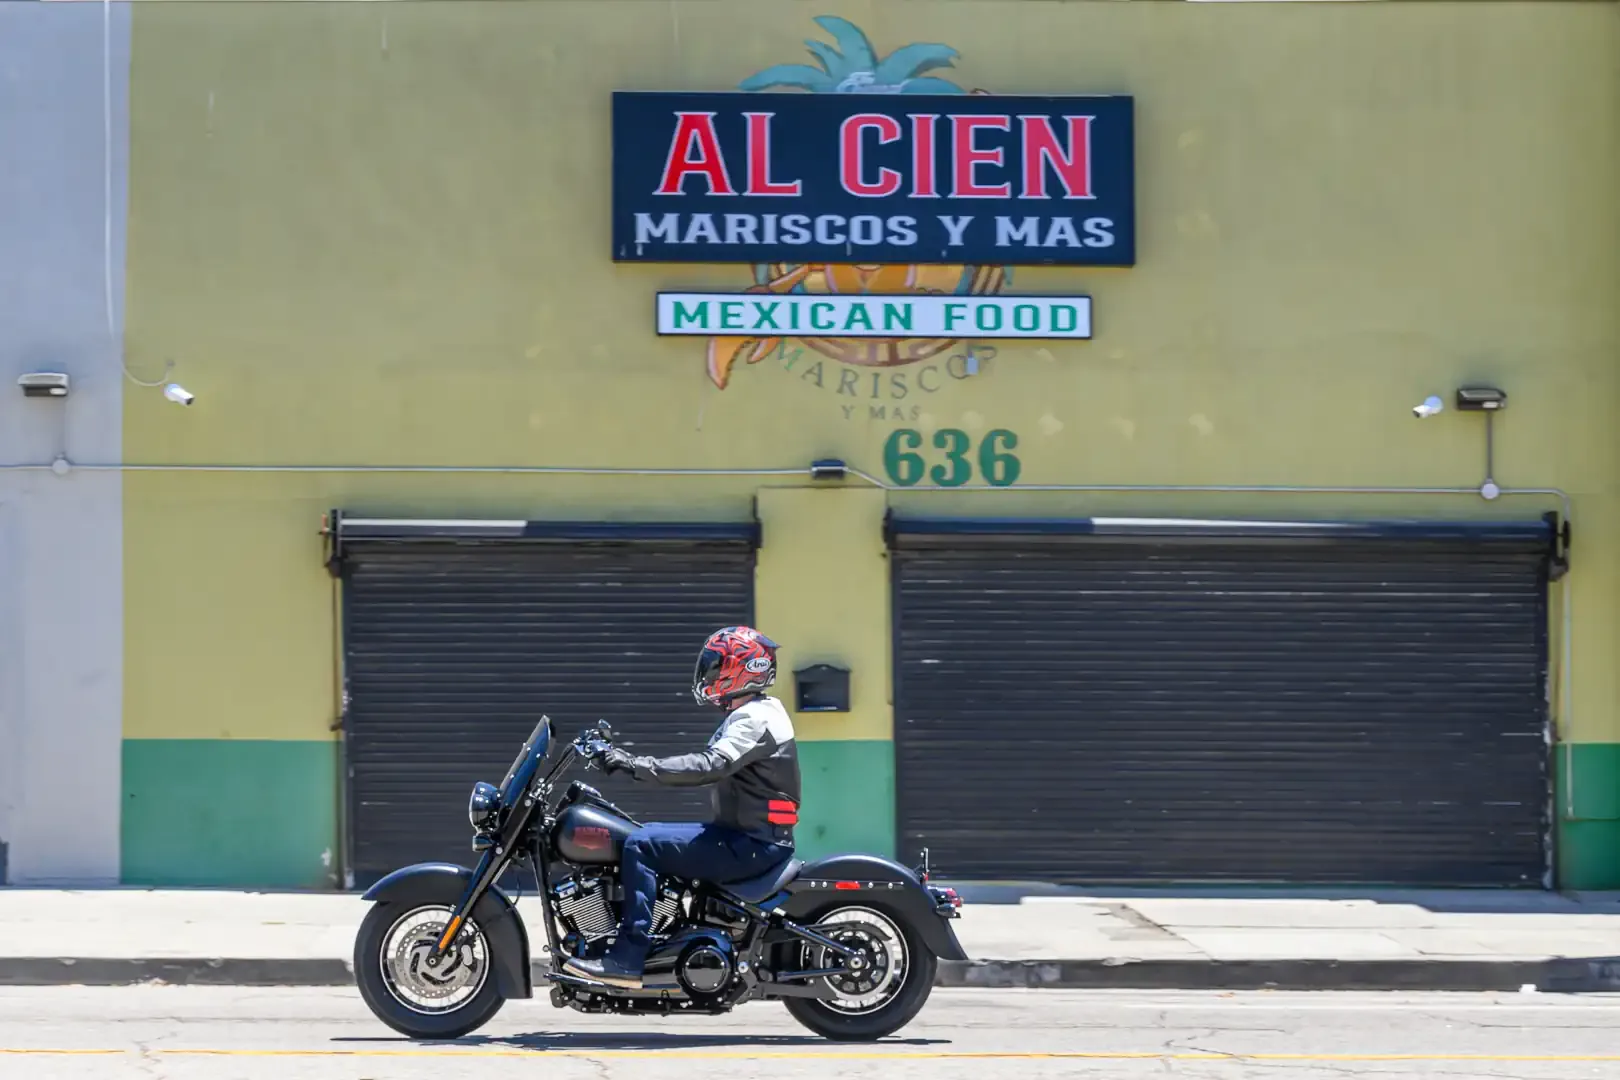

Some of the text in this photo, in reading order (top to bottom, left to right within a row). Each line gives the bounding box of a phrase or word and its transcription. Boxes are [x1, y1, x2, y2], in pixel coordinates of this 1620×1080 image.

[652, 111, 1097, 199] AL CIEN
[634, 212, 1116, 248] MARISCOS Y MAS
[673, 301, 1078, 332] MEXICAN FOOD
[840, 404, 922, 421] Y MAS
[883, 428, 1021, 487] 636
